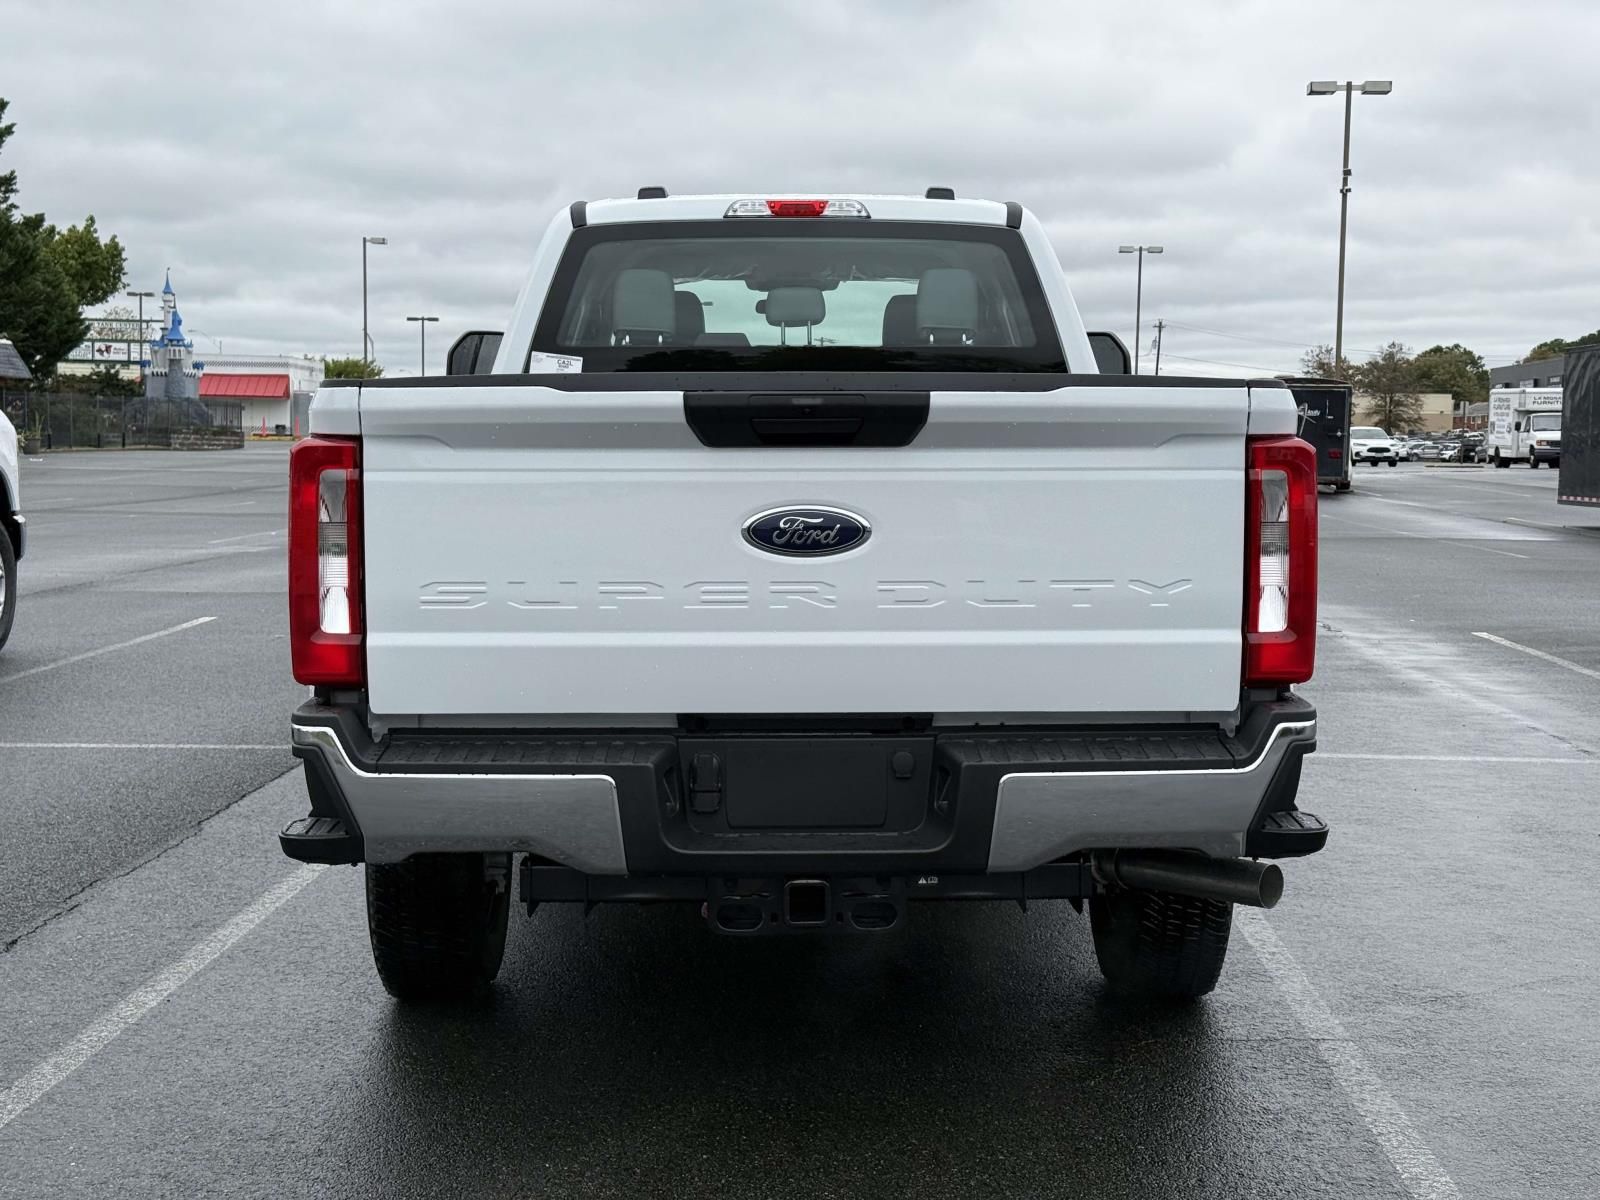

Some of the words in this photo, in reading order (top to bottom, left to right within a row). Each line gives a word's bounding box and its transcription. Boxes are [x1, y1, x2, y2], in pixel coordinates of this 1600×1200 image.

[772, 516, 841, 544] Ford
[419, 580, 837, 609] SUPER
[876, 578, 1193, 609] DUTY
